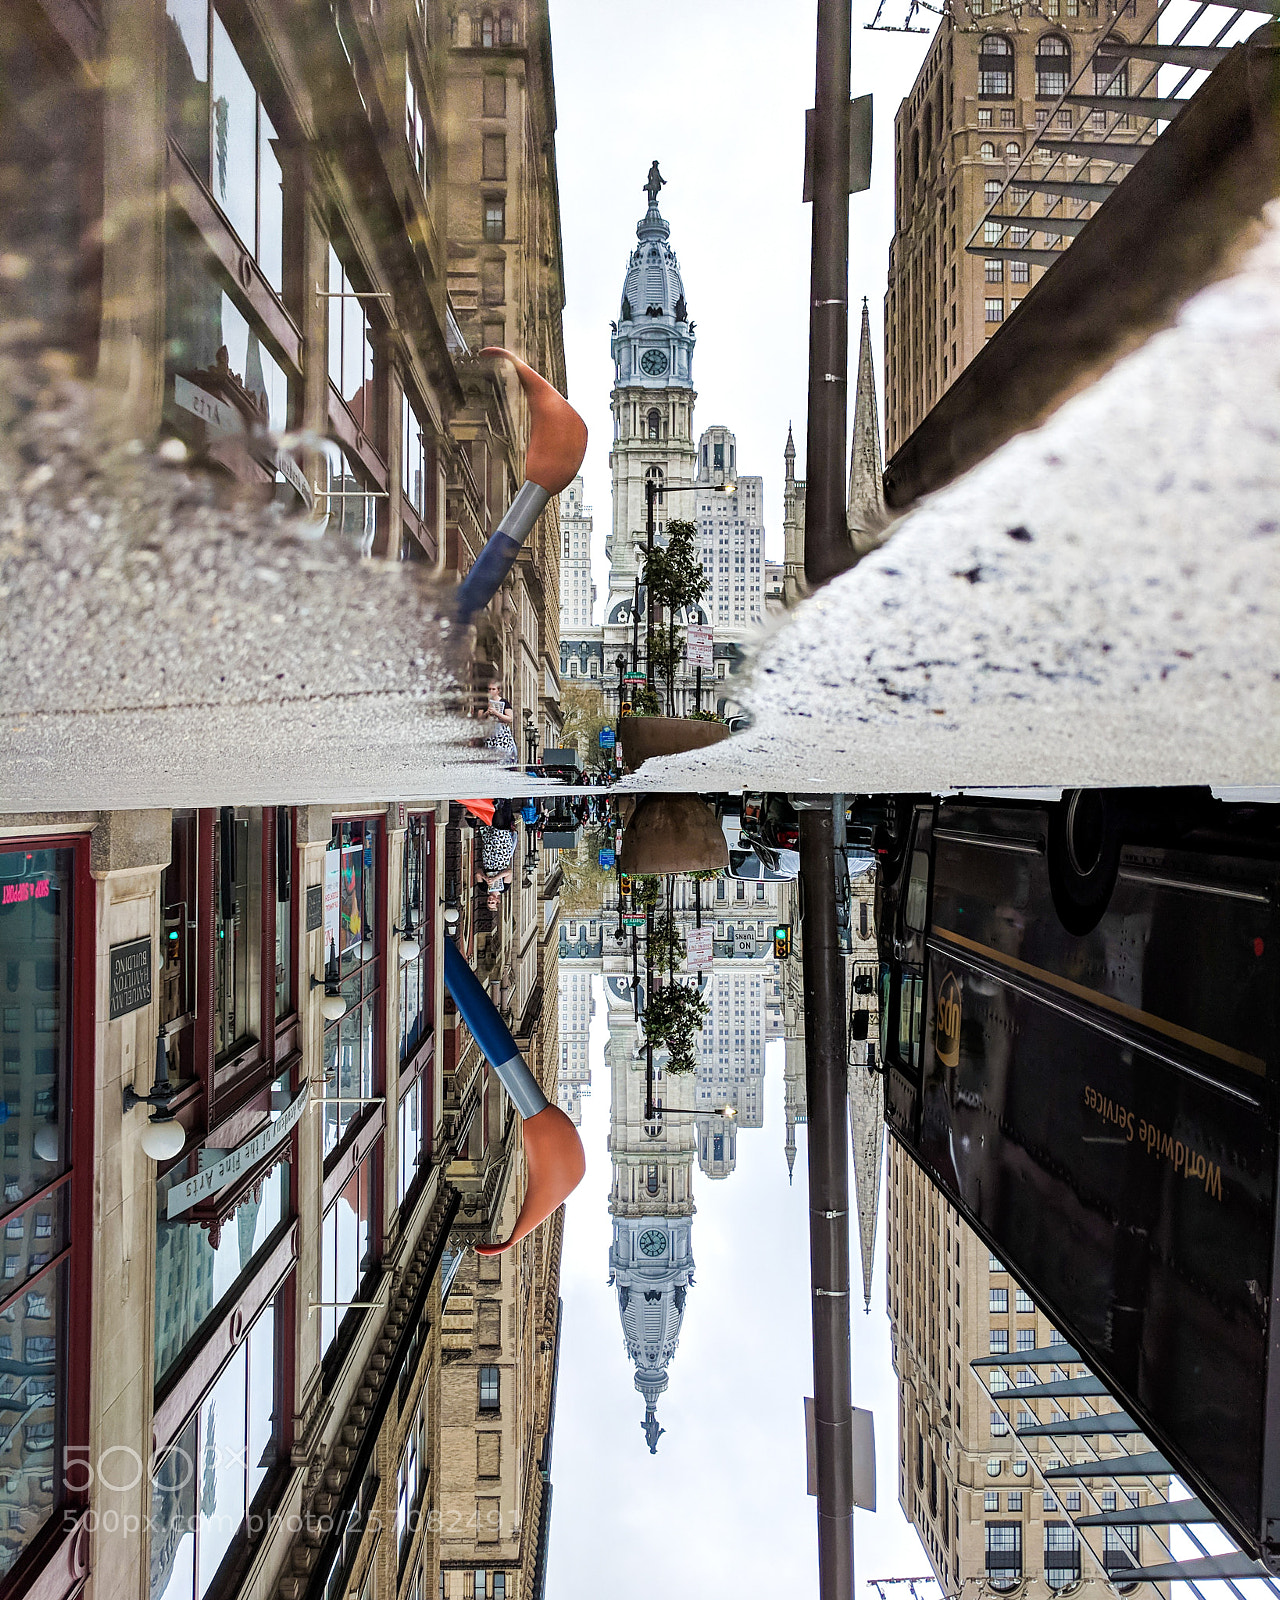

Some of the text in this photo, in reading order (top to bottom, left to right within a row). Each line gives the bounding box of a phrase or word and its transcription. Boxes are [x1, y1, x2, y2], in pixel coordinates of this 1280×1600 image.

[739, 941, 751, 950] NO
[115, 950, 147, 975] BUILDING
[113, 967, 149, 994] HAMILTON
[123, 982, 150, 1006] SAMUEL
[245, 1139, 260, 1161] the
[262, 1130, 271, 1150] of
[1084, 1084, 1223, 1201] Worldwide Services
[219, 1152, 241, 1178] Fine
[186, 1169, 214, 1198] Arts
